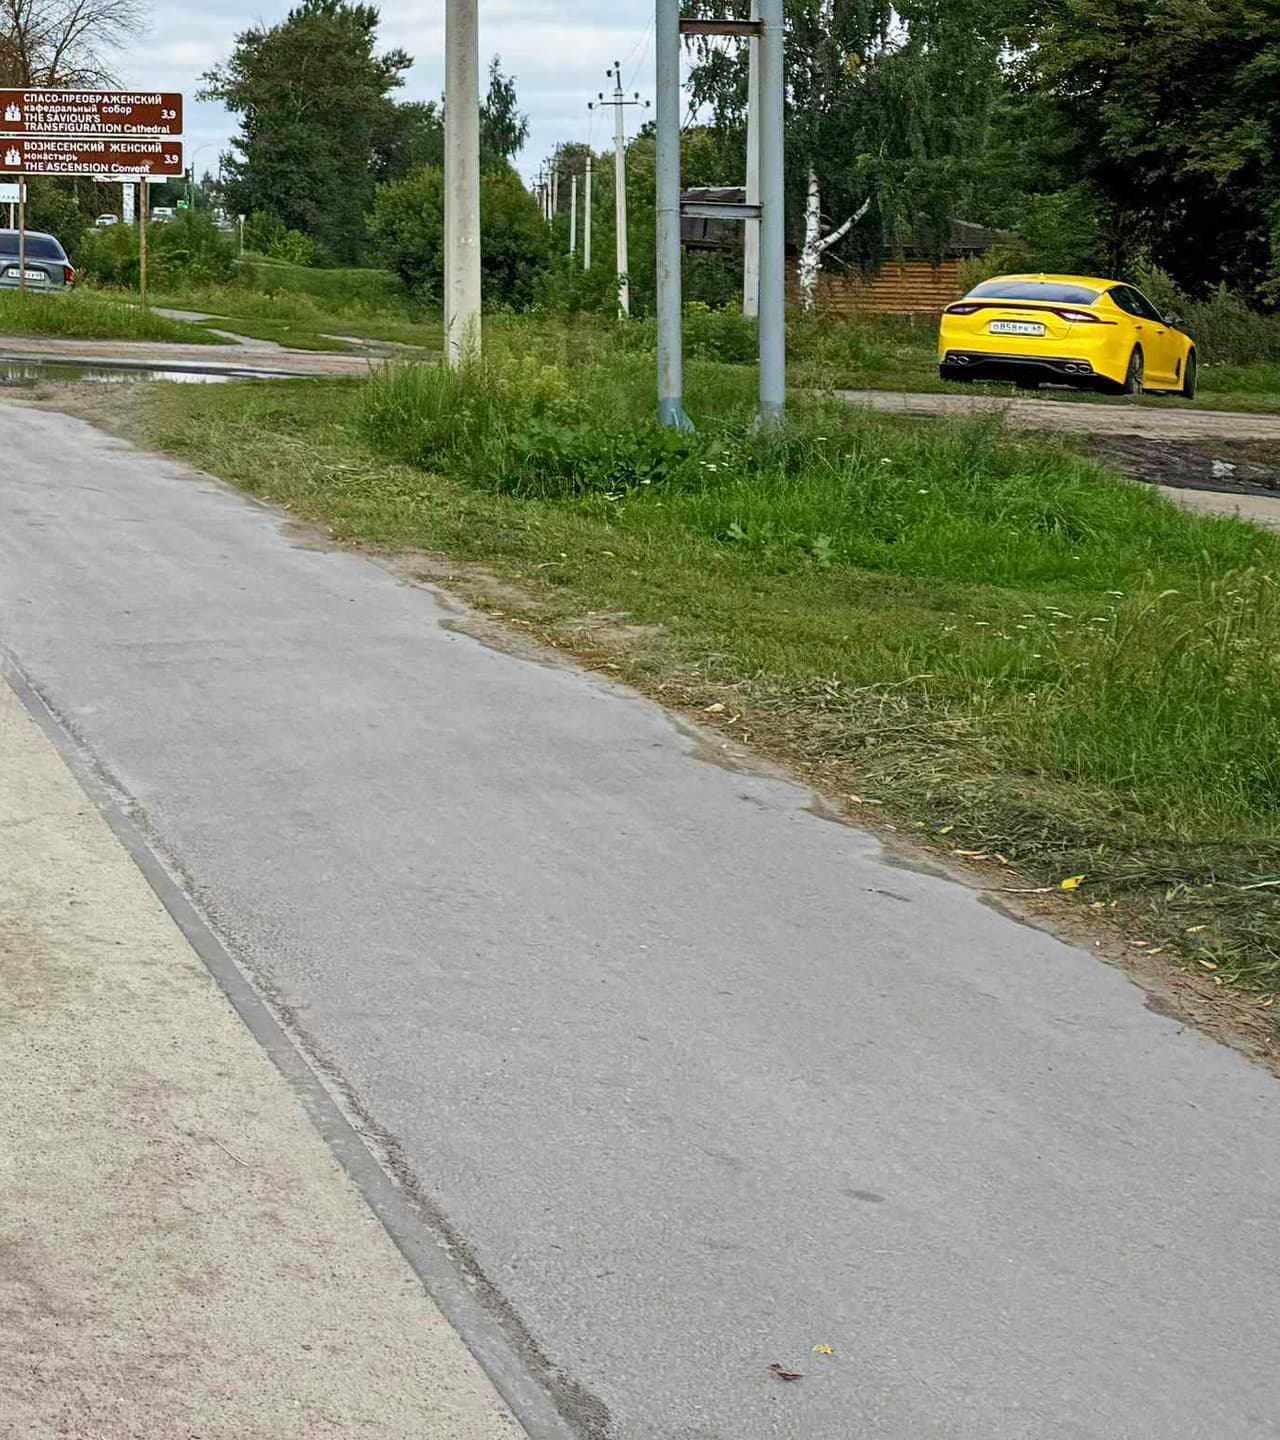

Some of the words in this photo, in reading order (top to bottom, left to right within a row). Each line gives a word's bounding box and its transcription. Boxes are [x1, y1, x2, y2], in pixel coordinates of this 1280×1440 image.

[23, 93, 162, 105] СПАСО-ПРЕОБРАЖЕНСКИЙ
[23, 104, 98, 115] кафедральный
[102, 105, 132, 115] собор
[24, 113, 44, 123] THE
[24, 122, 122, 133] TRANSFIGURATION
[123, 124, 171, 134] Cathedral
[23, 141, 105, 152] ВОЗНЕСЕНСКИЙ
[109, 142, 162, 153] ЖЕНСКИЙ
[23, 153, 78, 161] монастырь
[24, 162, 44, 172] THE
[46, 162, 109, 173] ASCENSION
[111, 164, 151, 173] Convent
